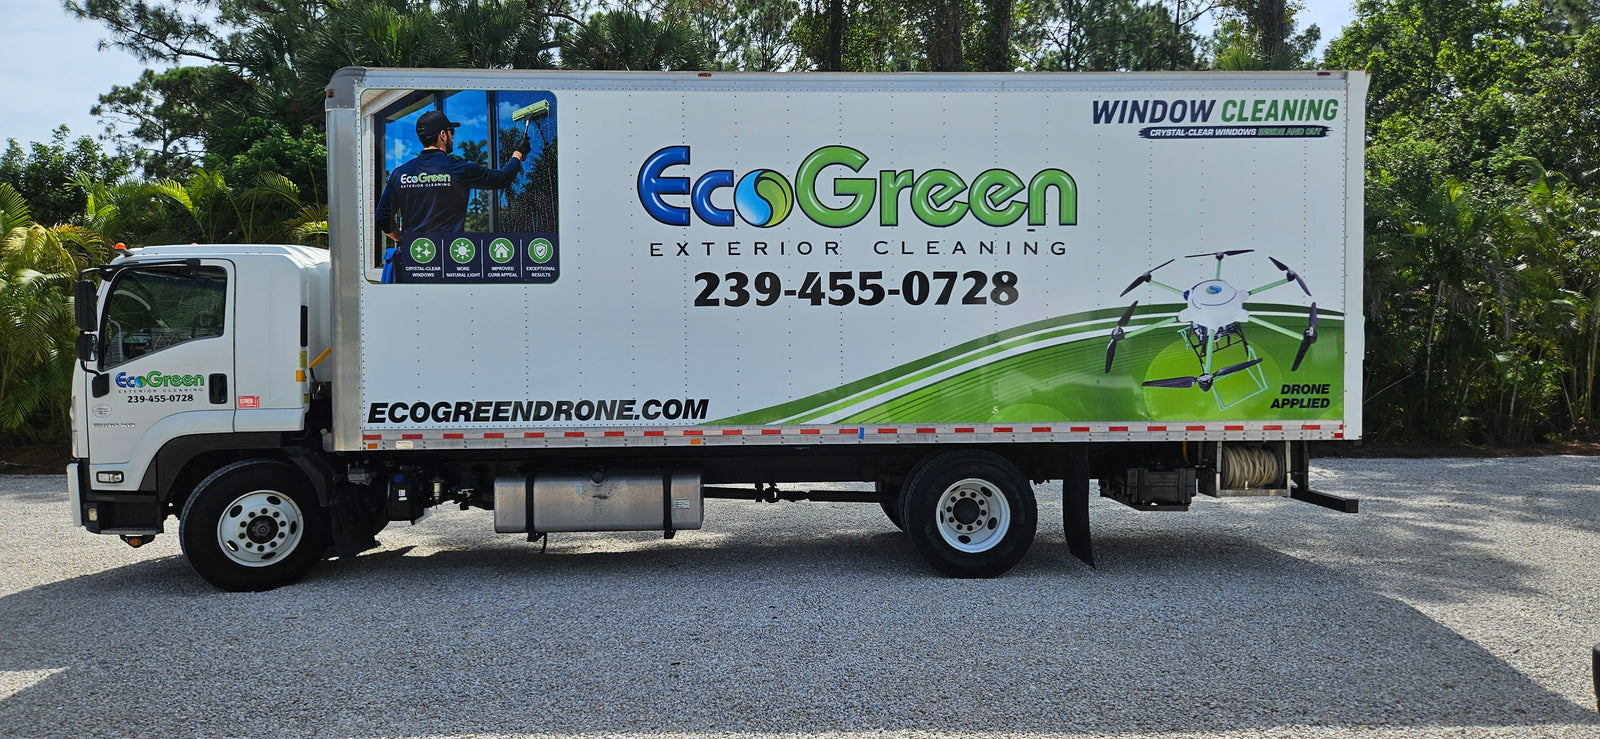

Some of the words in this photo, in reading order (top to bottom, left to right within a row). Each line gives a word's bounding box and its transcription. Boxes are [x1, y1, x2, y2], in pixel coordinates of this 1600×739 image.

[1092, 99, 1216, 124] WINDOW
[1221, 98, 1338, 122] CLEANING
[1149, 128, 1213, 137] CRYSTAL-CLEAR
[1214, 127, 1257, 136] WINDOWS
[400, 172, 451, 183] EcoGreen
[637, 145, 1078, 229] EcoGreen
[649, 241, 840, 256] EXTERIOR
[873, 240, 1067, 256] CLEANING
[693, 271, 1019, 307] 239-455-0728
[115, 371, 204, 388] EcoGreen
[1280, 384, 1330, 394] DRONE
[127, 394, 194, 403] 239-455-0728
[1270, 398, 1330, 408] APPLIED
[367, 399, 709, 423] ECOGREENDRONE.COM
